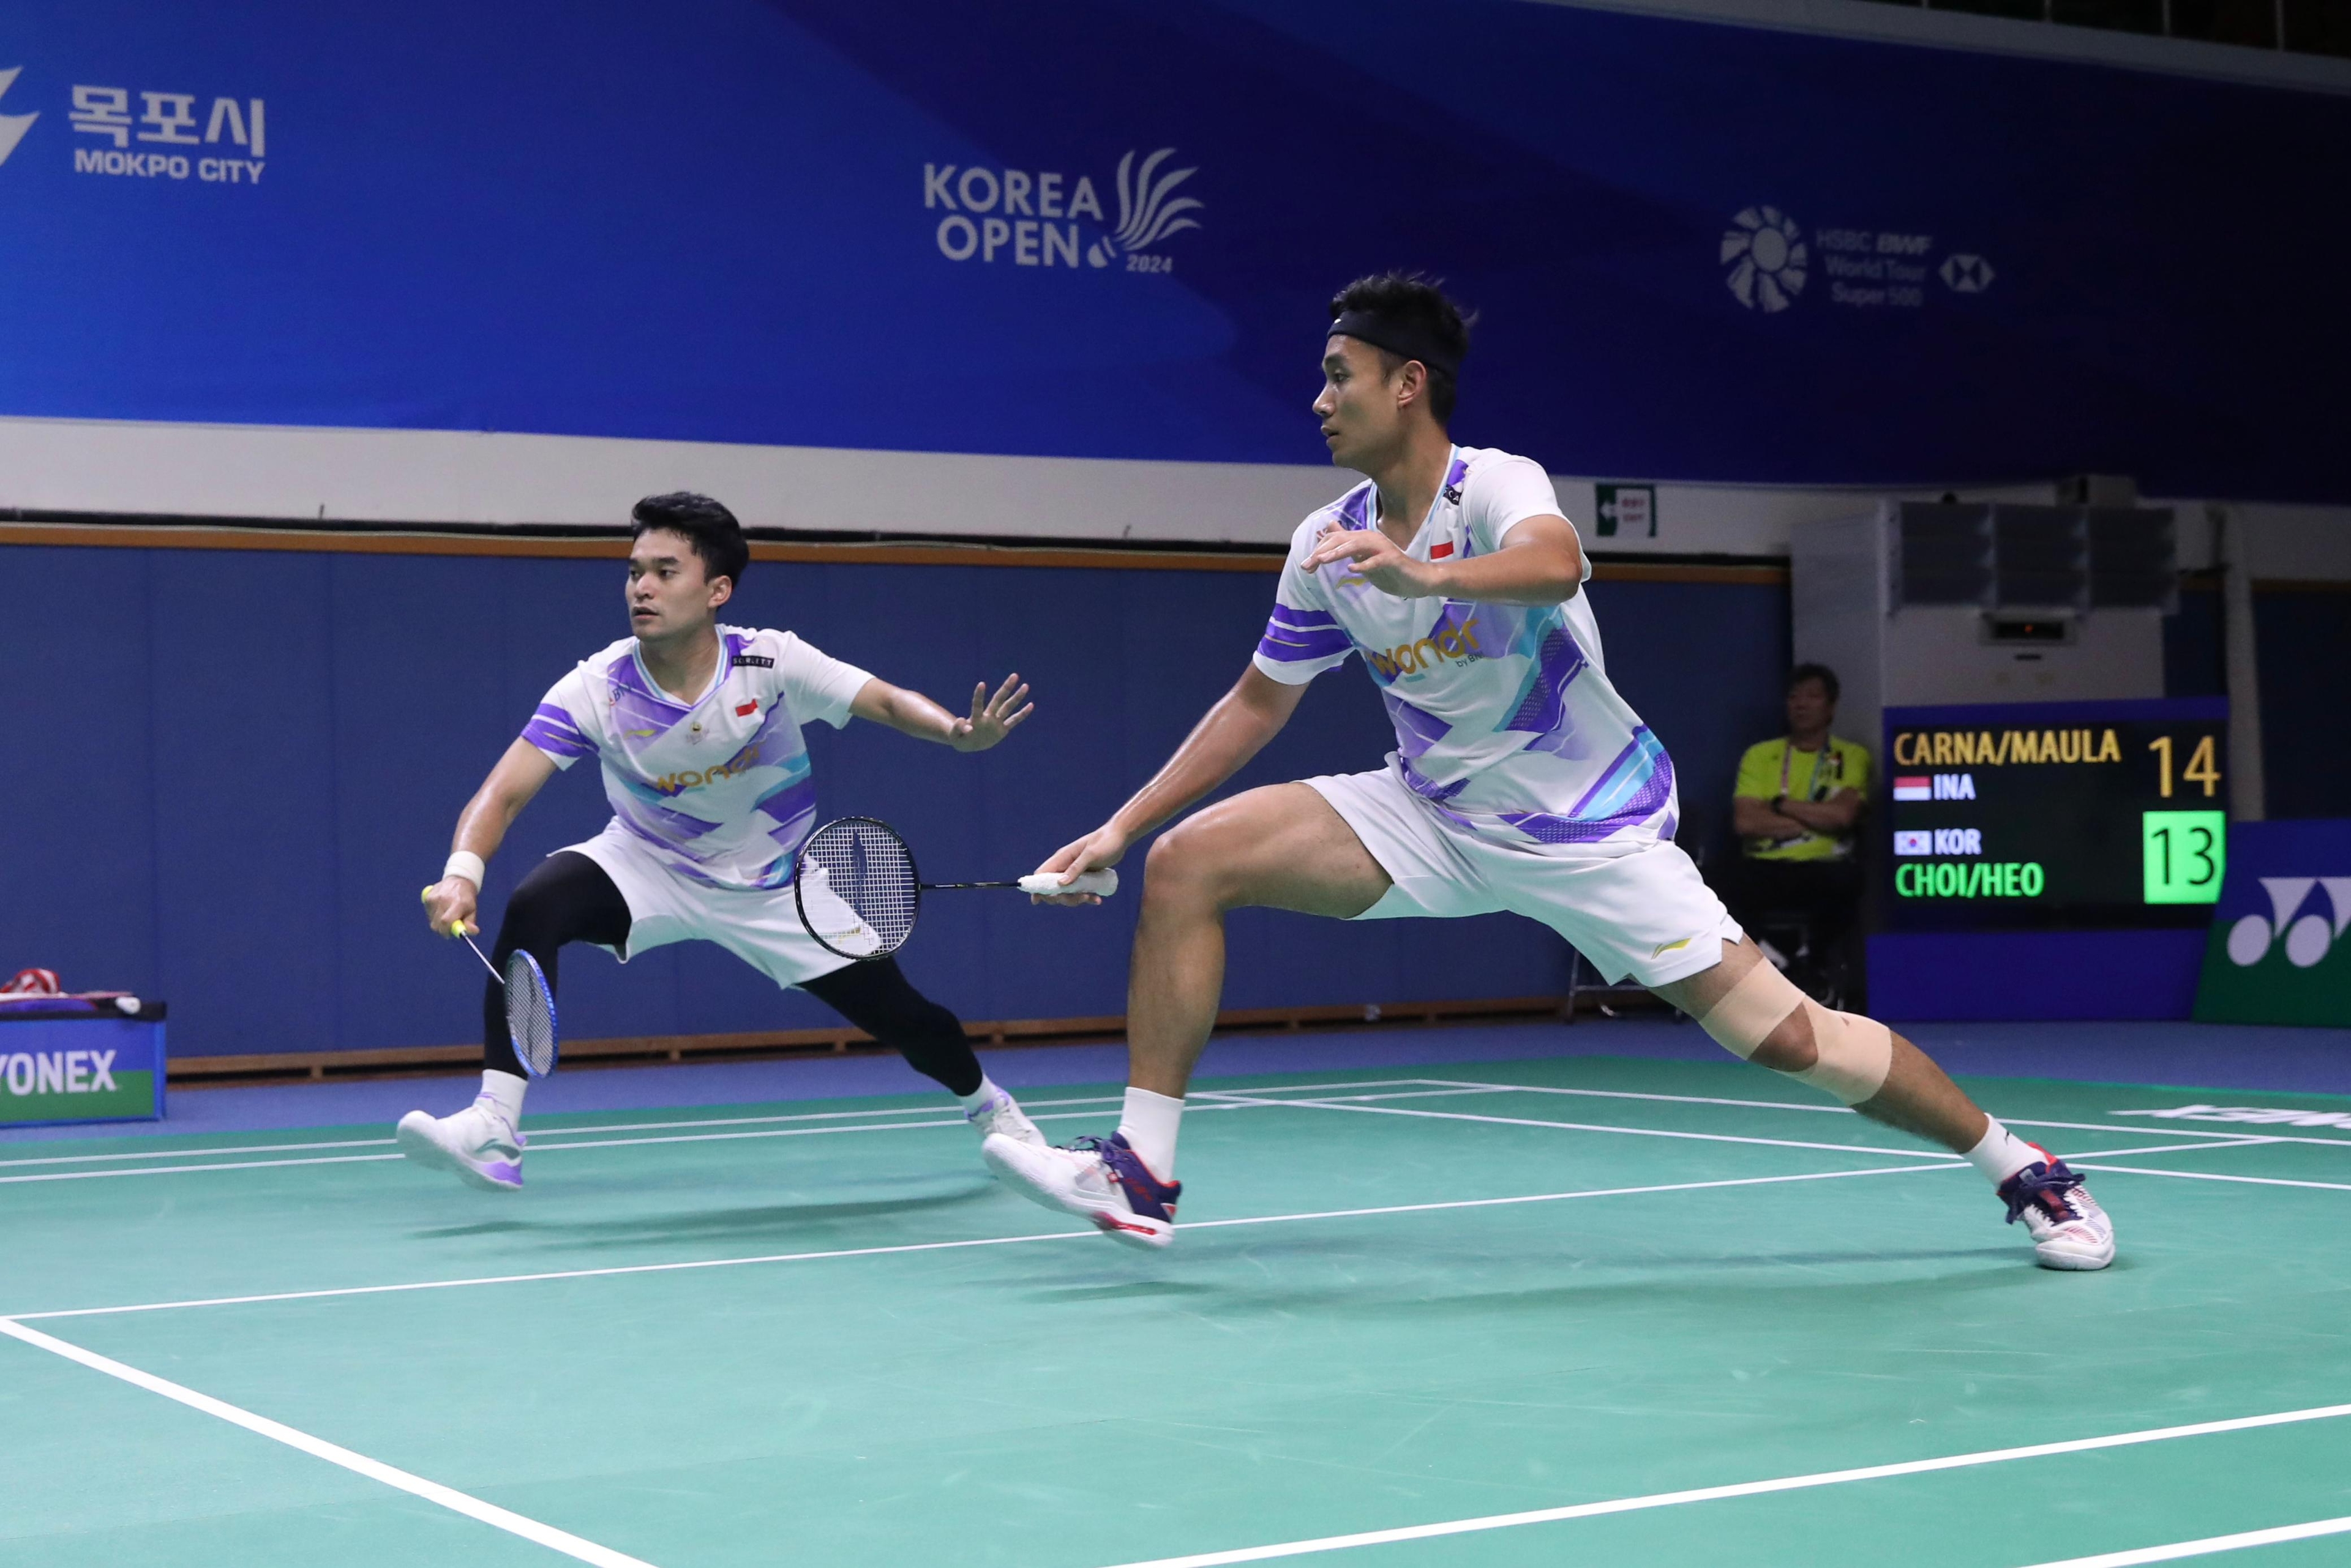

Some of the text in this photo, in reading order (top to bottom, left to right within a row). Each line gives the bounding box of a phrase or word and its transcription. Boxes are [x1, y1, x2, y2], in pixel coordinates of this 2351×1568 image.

[69, 84, 266, 157] 목포시
[74, 148, 266, 184] MOKPO CITY
[923, 163, 1104, 221] KOREA
[936, 214, 1079, 268] OPEN
[1816, 228, 1933, 255] HSBC BWF
[1126, 253, 1173, 273] 2024
[1824, 254, 1927, 282] World Tour
[1831, 280, 1924, 307] Super 500
[1366, 617, 1479, 675] wondr
[1893, 729, 2221, 798] CARNA/MAULA 14
[1933, 773, 1977, 801] INA
[1934, 825, 2215, 886] KOR 13
[1895, 861, 2045, 898] CHOI/HEO
